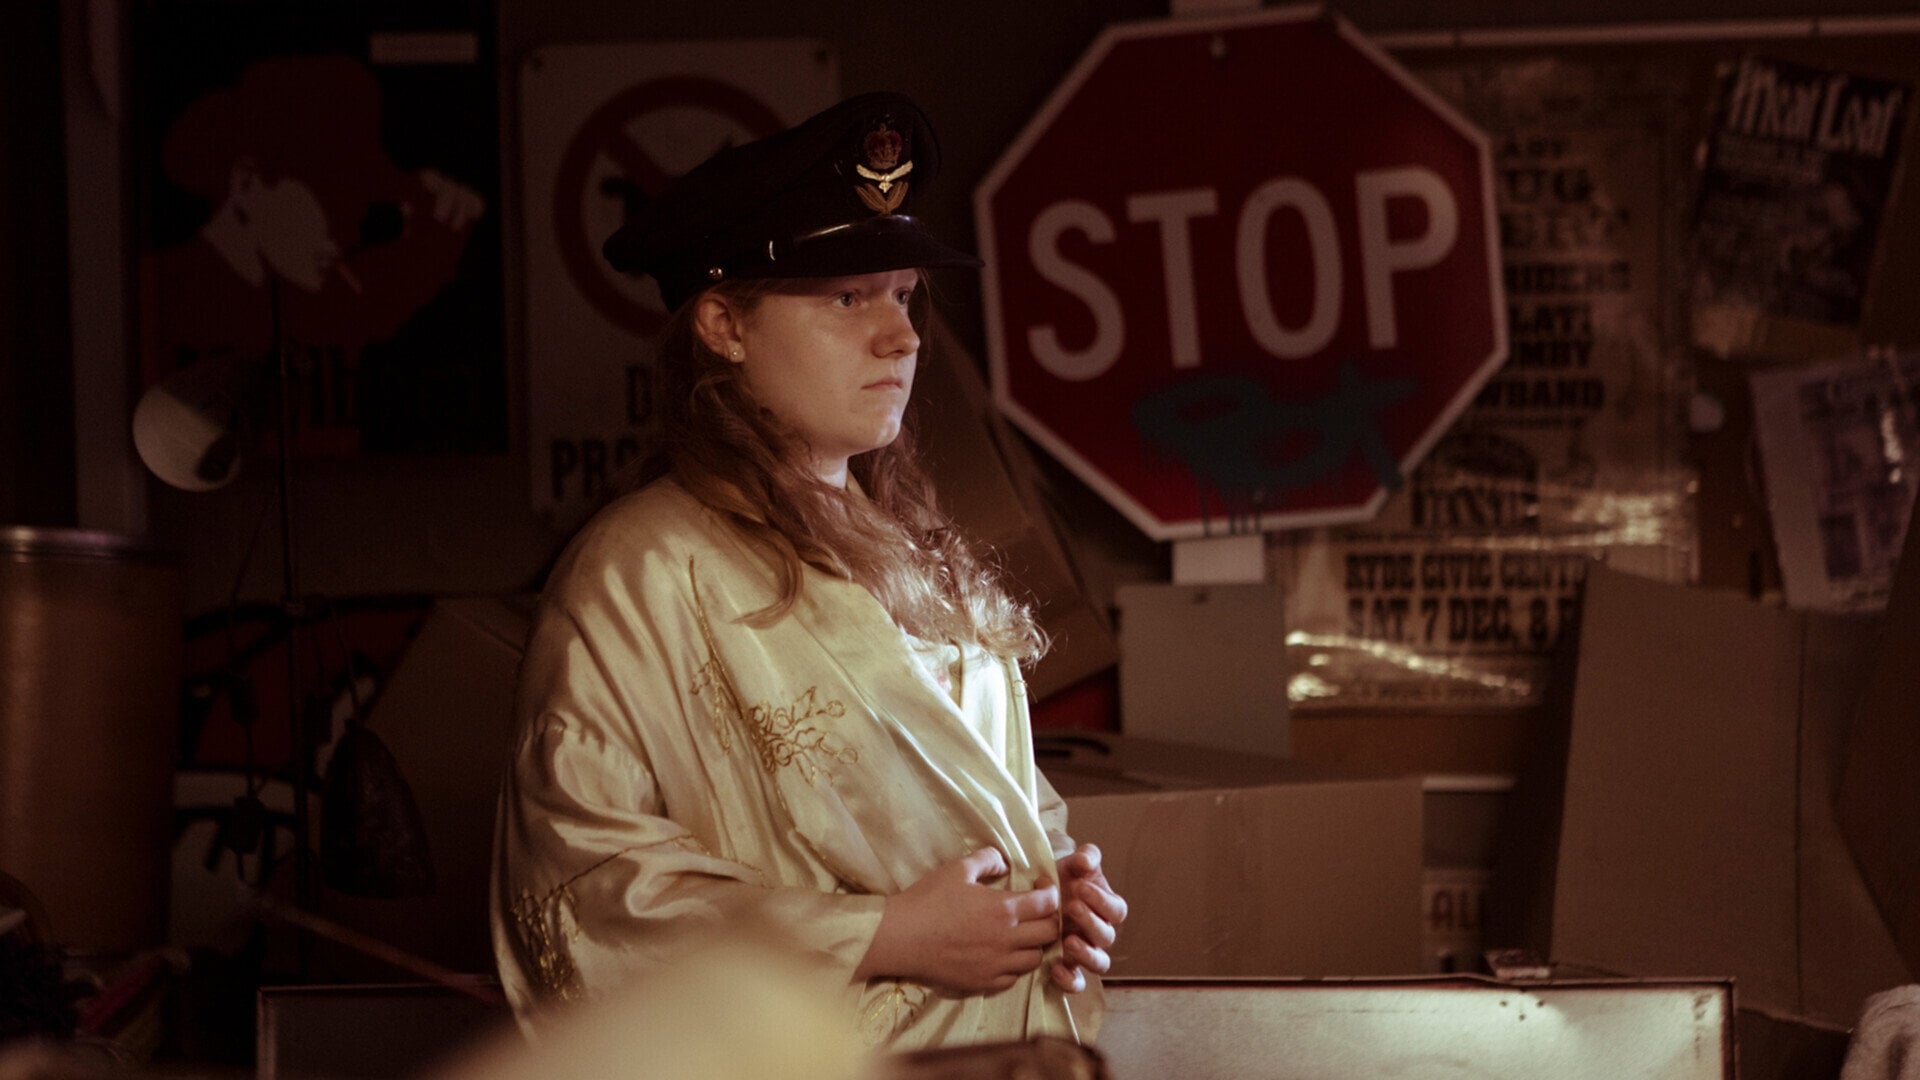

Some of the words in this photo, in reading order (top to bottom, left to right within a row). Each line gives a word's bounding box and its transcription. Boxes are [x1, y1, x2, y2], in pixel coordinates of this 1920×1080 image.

[1027, 165, 1460, 382] STOP
[1346, 553, 1413, 589] RYDE
[1421, 553, 1491, 589] CIVIC
[1421, 598, 1439, 642] 7
